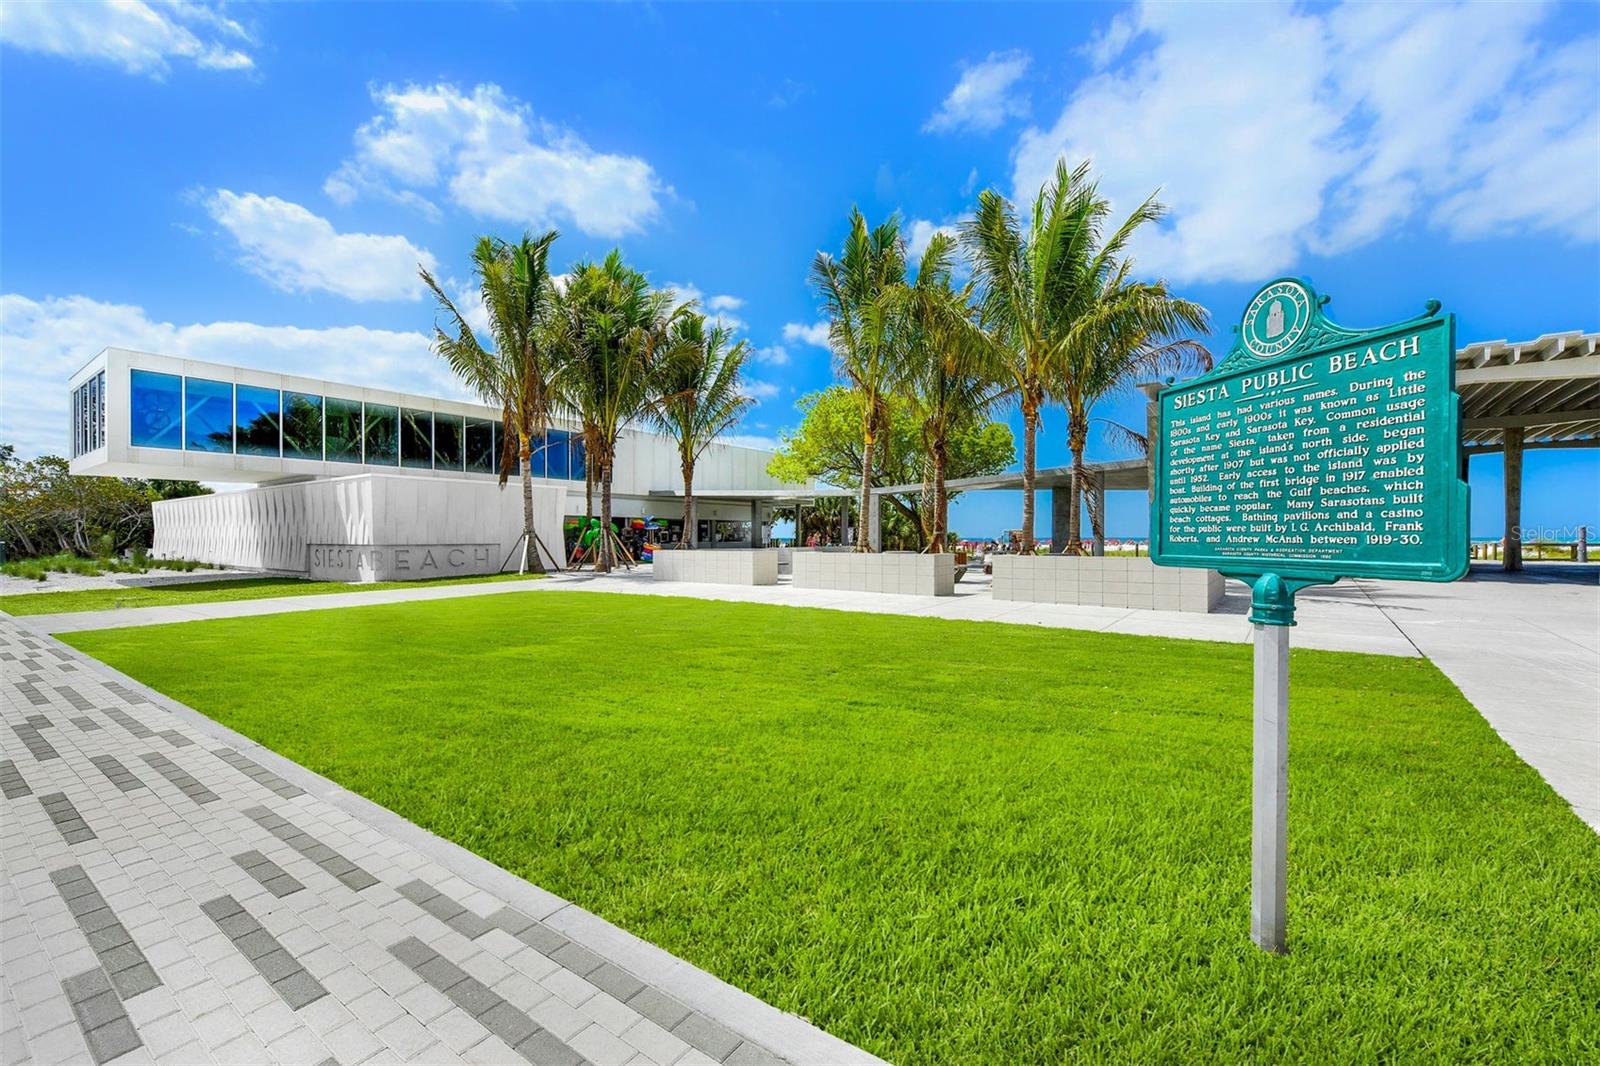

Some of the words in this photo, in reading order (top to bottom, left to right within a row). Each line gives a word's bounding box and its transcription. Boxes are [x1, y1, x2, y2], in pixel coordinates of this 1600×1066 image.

[1245, 286, 1306, 326] SARASOTA
[1249, 326, 1301, 354] COUNTY
[1174, 385, 1229, 409] SIESTA
[1242, 362, 1313, 393] PUBLIC
[1329, 336, 1419, 374] BEACH
[1170, 419, 1185, 428] This
[1190, 413, 1211, 424] island
[1217, 410, 1231, 419] has
[1236, 405, 1253, 415] had
[1260, 396, 1296, 410] various
[1303, 388, 1338, 402] names.
[1350, 376, 1394, 392] During
[1404, 370, 1427, 382] the
[1196, 424, 1210, 433] and
[1216, 419, 1238, 429] early
[1244, 412, 1272, 424] 1900s
[1279, 409, 1287, 417] it
[1294, 406, 1313, 415] was
[1320, 397, 1357, 410] known
[1366, 393, 1380, 402] as
[1390, 384, 1426, 398] Little
[1170, 436, 1200, 447] Sarasota
[1205, 433, 1220, 442] Key
[1225, 428, 1241, 438] and
[1246, 422, 1288, 435] Sarasota
[1294, 416, 1316, 427] Key.
[1326, 406, 1376, 421] Common
[1386, 398, 1426, 411] usage
[1170, 449, 1178, 457] of
[1184, 446, 1196, 455] the
[1202, 444, 1223, 452] name
[1268, 432, 1295, 442] taken
[1303, 426, 1329, 437] from
[1339, 424, 1346, 432] a
[1356, 410, 1425, 429] residential
[1170, 454, 1215, 466] development
[1221, 452, 1230, 460] at
[1237, 449, 1252, 458] the
[1259, 441, 1294, 455] island's
[1302, 437, 1333, 449] north
[1384, 426, 1425, 439] began
[1170, 466, 1195, 476] shortly
[1199, 464, 1219, 472] after
[1224, 460, 1244, 470] 1907
[1250, 458, 1265, 467] but
[1271, 456, 1288, 464] was
[1293, 452, 1310, 462] not
[1317, 445, 1369, 459] officially
[1376, 438, 1425, 454] applied
[1170, 477, 1186, 485] until
[1219, 472, 1241, 480] Early
[1247, 468, 1277, 478] access
[1284, 466, 1295, 474] to
[1303, 464, 1320, 473] the
[1328, 458, 1363, 470] island
[1373, 456, 1397, 466] was
[1408, 453, 1425, 464] by
[1191, 484, 1223, 493] Building
[1226, 482, 1236, 490] of
[1240, 481, 1255, 489] the
[1260, 478, 1280, 488] first
[1285, 476, 1320, 487] bridge
[1326, 474, 1336, 483] in
[1342, 470, 1366, 481] 1917
[1373, 465, 1425, 479] enabled
[1170, 495, 1212, 504] automobiles
[1234, 492, 1259, 500] reach
[1267, 490, 1283, 498] the
[1290, 487, 1312, 497] Gulf
[1384, 480, 1424, 491] which
[1170, 506, 1196, 515] quickly
[1200, 504, 1231, 512] became
[1236, 502, 1273, 512] popular.
[1287, 500, 1314, 510] Many
[1320, 496, 1386, 507] Sarasotans
[1393, 494, 1425, 504] built
[1184, 525, 1196, 533] the
[1198, 524, 1222, 534] public
[1250, 524, 1272, 532] built
[1275, 524, 1288, 534] by
[1300, 522, 1310, 532] G.
[1385, 521, 1424, 531] Frank
[1196, 514, 1232, 524] cottages.
[1242, 513, 1278, 523] Bathing
[1284, 511, 1330, 522] pavilions
[1336, 510, 1358, 519] and
[1366, 510, 1373, 518] a
[1380, 508, 1424, 518] casino
[1226, 535, 1260, 543] Andrew
[1266, 534, 1303, 544] McAnsh
[1310, 534, 1358, 544] between
[314, 548, 363, 571] SIESTA
[371, 548, 490, 571] BEACH
